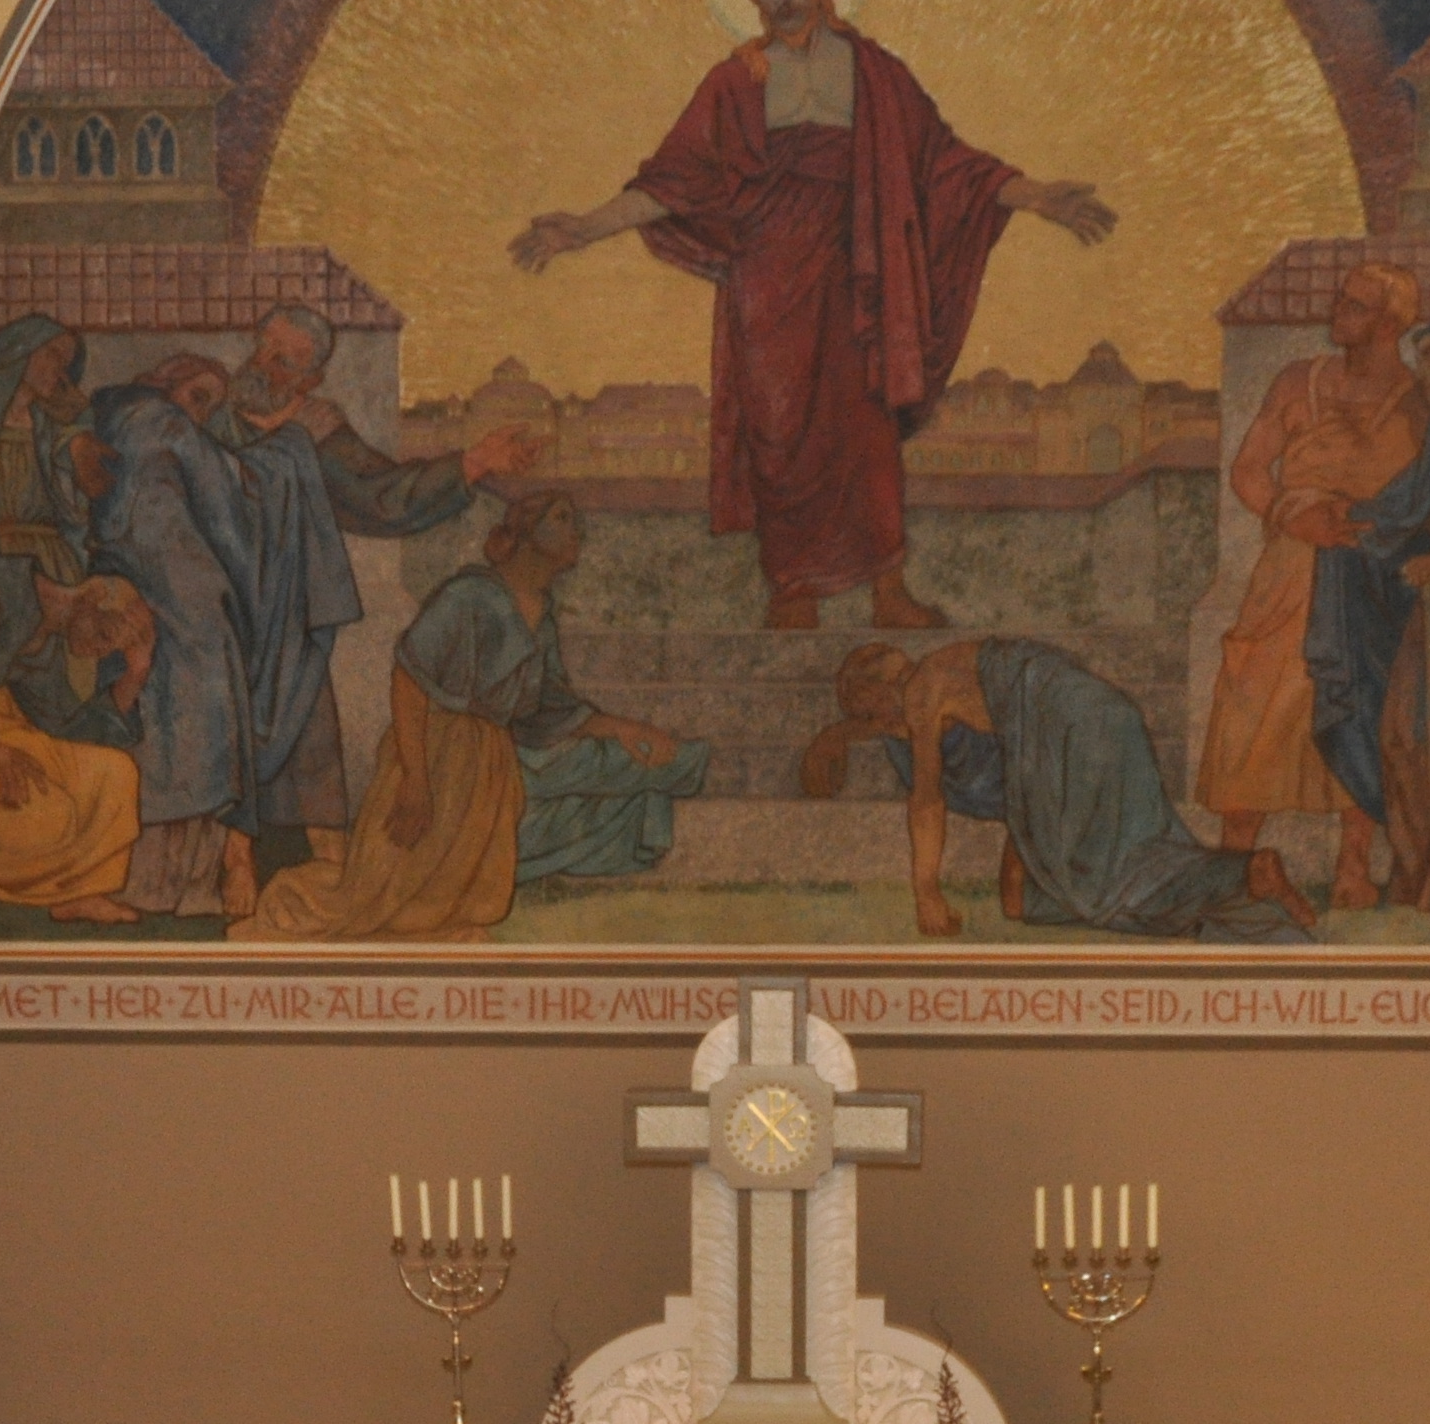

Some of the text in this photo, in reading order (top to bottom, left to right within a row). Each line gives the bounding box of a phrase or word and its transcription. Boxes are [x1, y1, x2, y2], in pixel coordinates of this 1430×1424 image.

[88, 984, 163, 1019] HER
[179, 984, 228, 1020] ZU
[245, 985, 313, 1020] MIR
[444, 986, 505, 1021] DIE
[527, 986, 600, 1021] IHR
[609, 986, 739, 1022] MÜHSE
[821, 987, 888, 1022] UND
[908, 988, 1083, 1023] BELADEN
[1100, 989, 1193, 1024] SEID,
[1202, 989, 1259, 1024] ICH
[1274, 989, 1359, 1024] WILL
